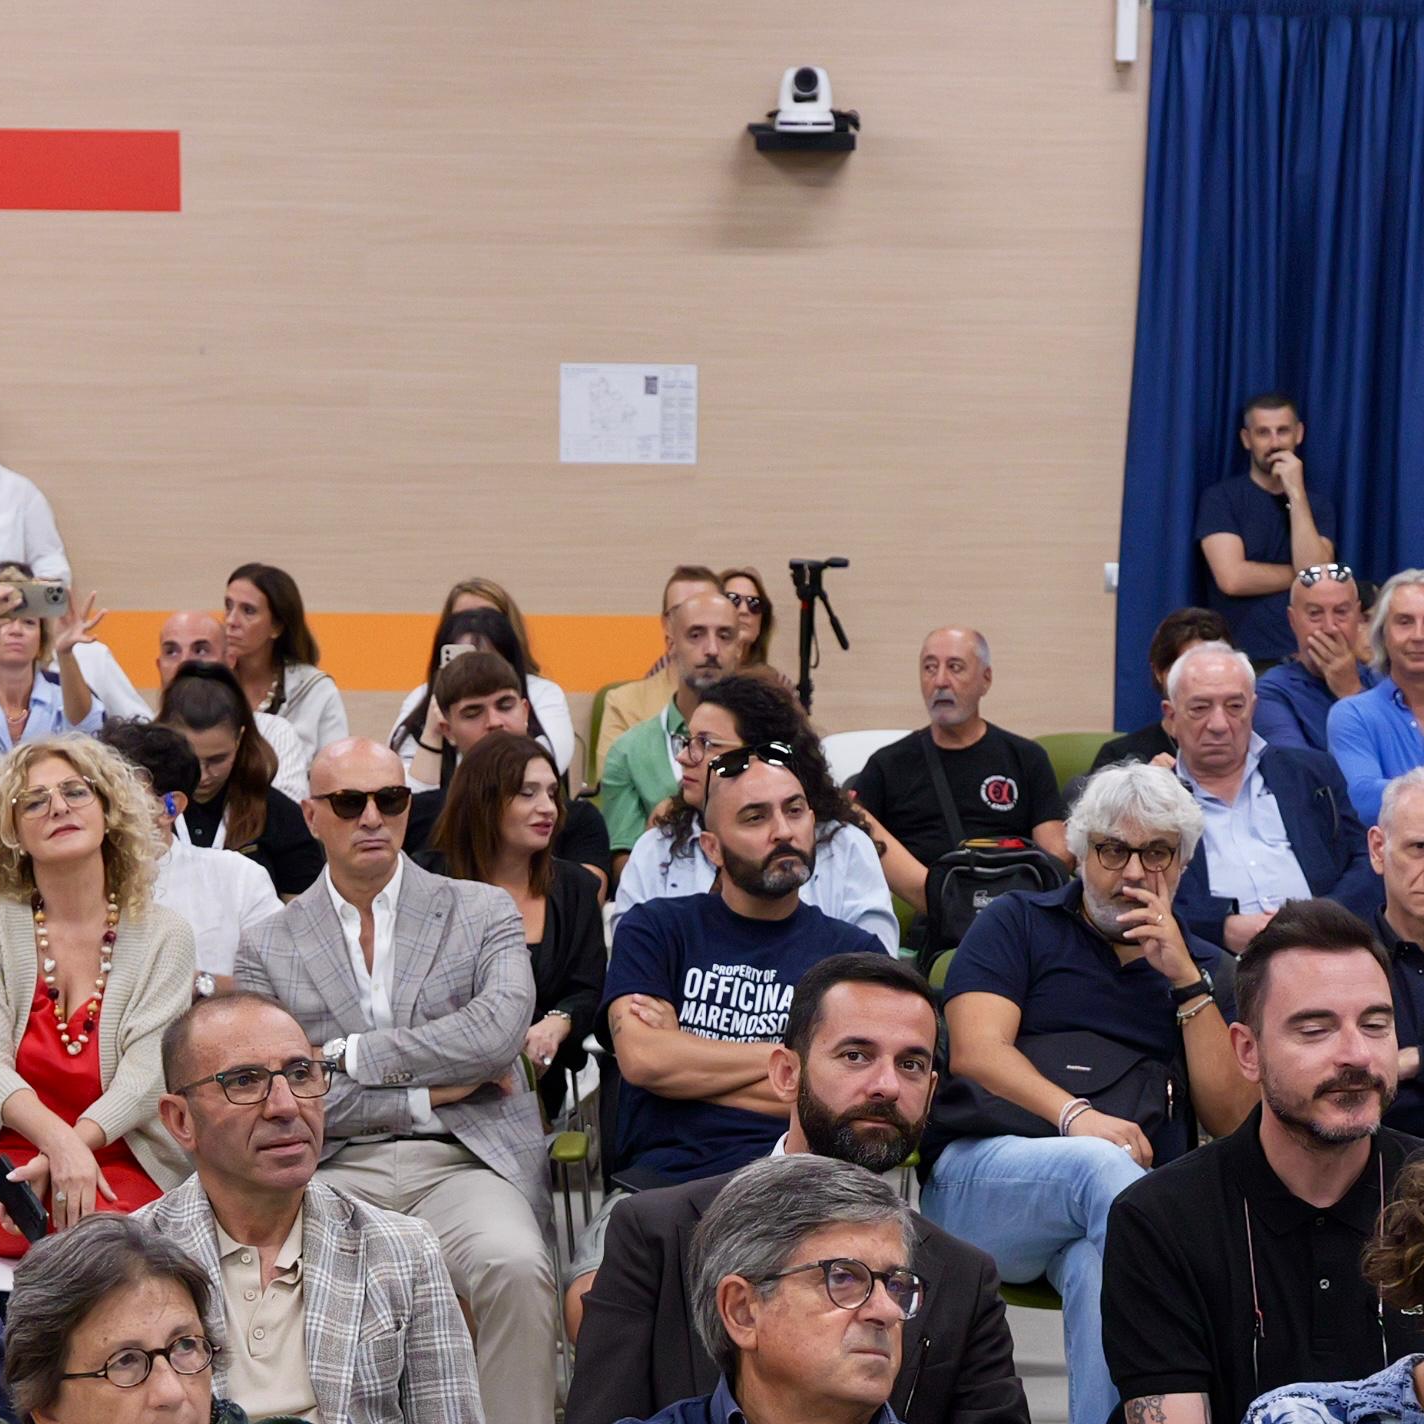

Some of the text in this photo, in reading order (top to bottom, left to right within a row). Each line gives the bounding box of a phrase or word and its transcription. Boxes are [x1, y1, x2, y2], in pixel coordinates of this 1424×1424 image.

[683, 967, 794, 1013] OFFICINA
[712, 964, 777, 983] PROPERTY OF
[679, 1001, 789, 1036] MAREMOSSO
